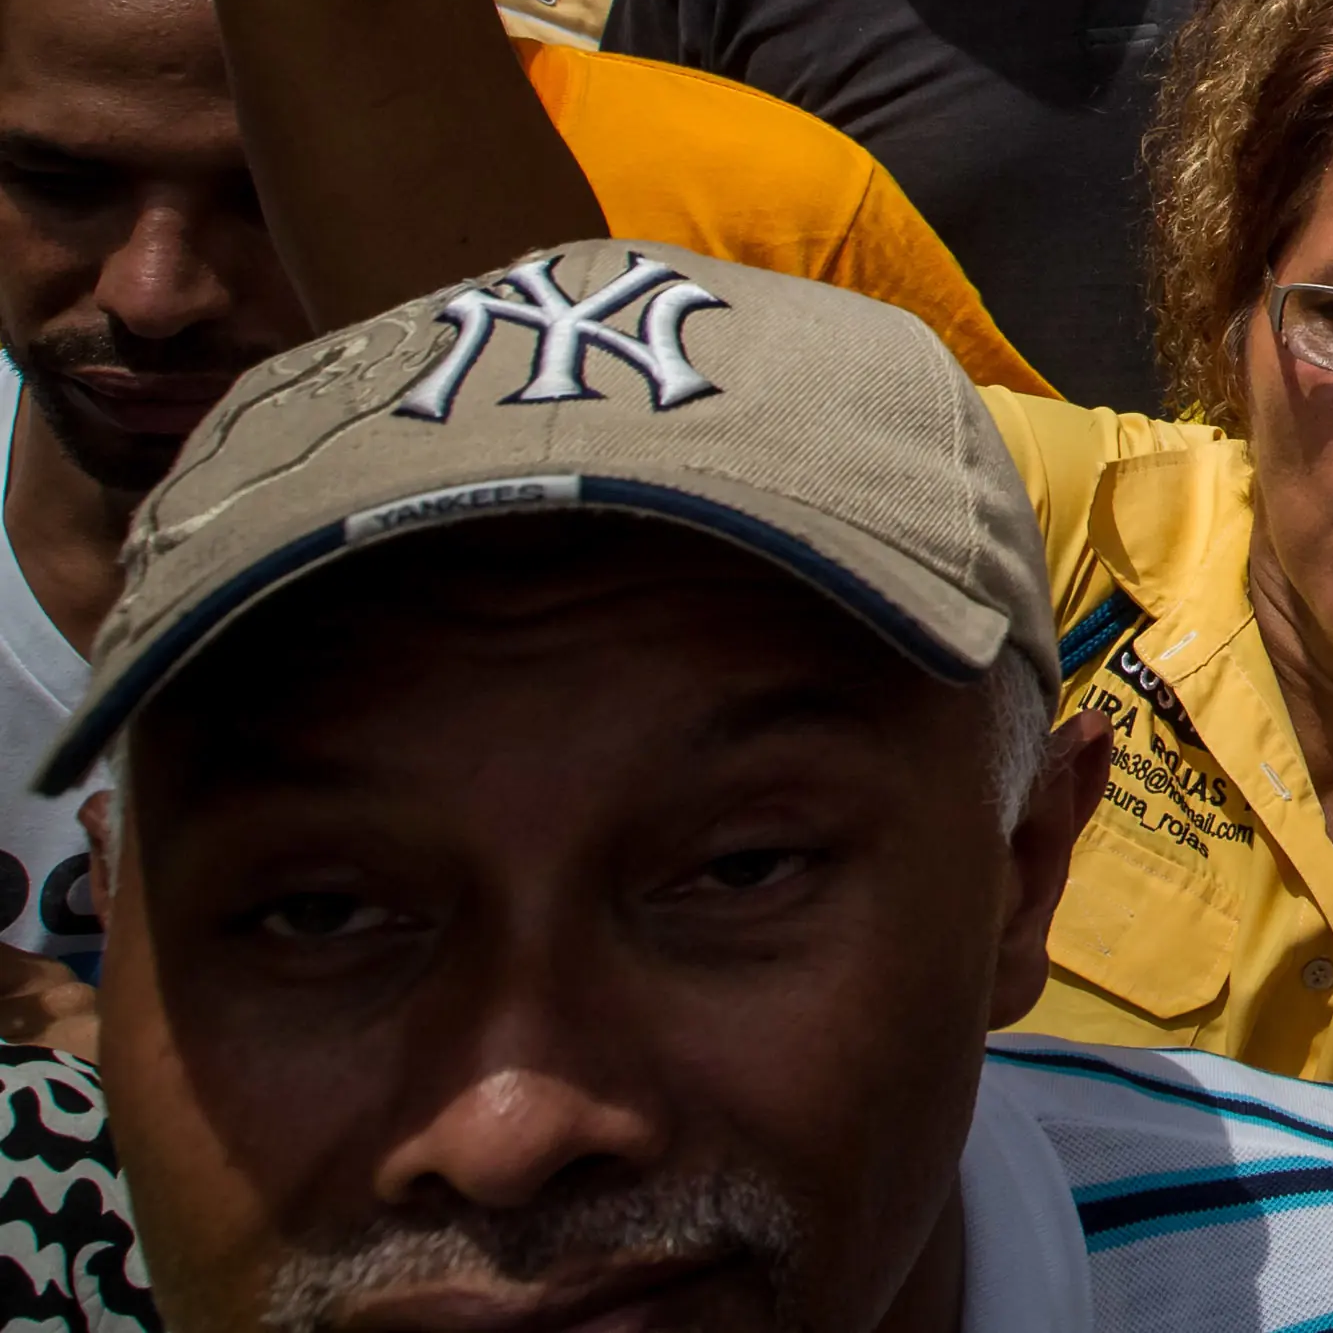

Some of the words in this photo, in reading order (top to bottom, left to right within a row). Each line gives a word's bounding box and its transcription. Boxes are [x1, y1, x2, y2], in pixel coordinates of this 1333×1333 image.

[373, 483, 545, 530] YANKEES
[1078, 684, 1138, 739] URA
[1151, 733, 1227, 807] ROJAS
[1103, 778, 1209, 859] aura_rojas
